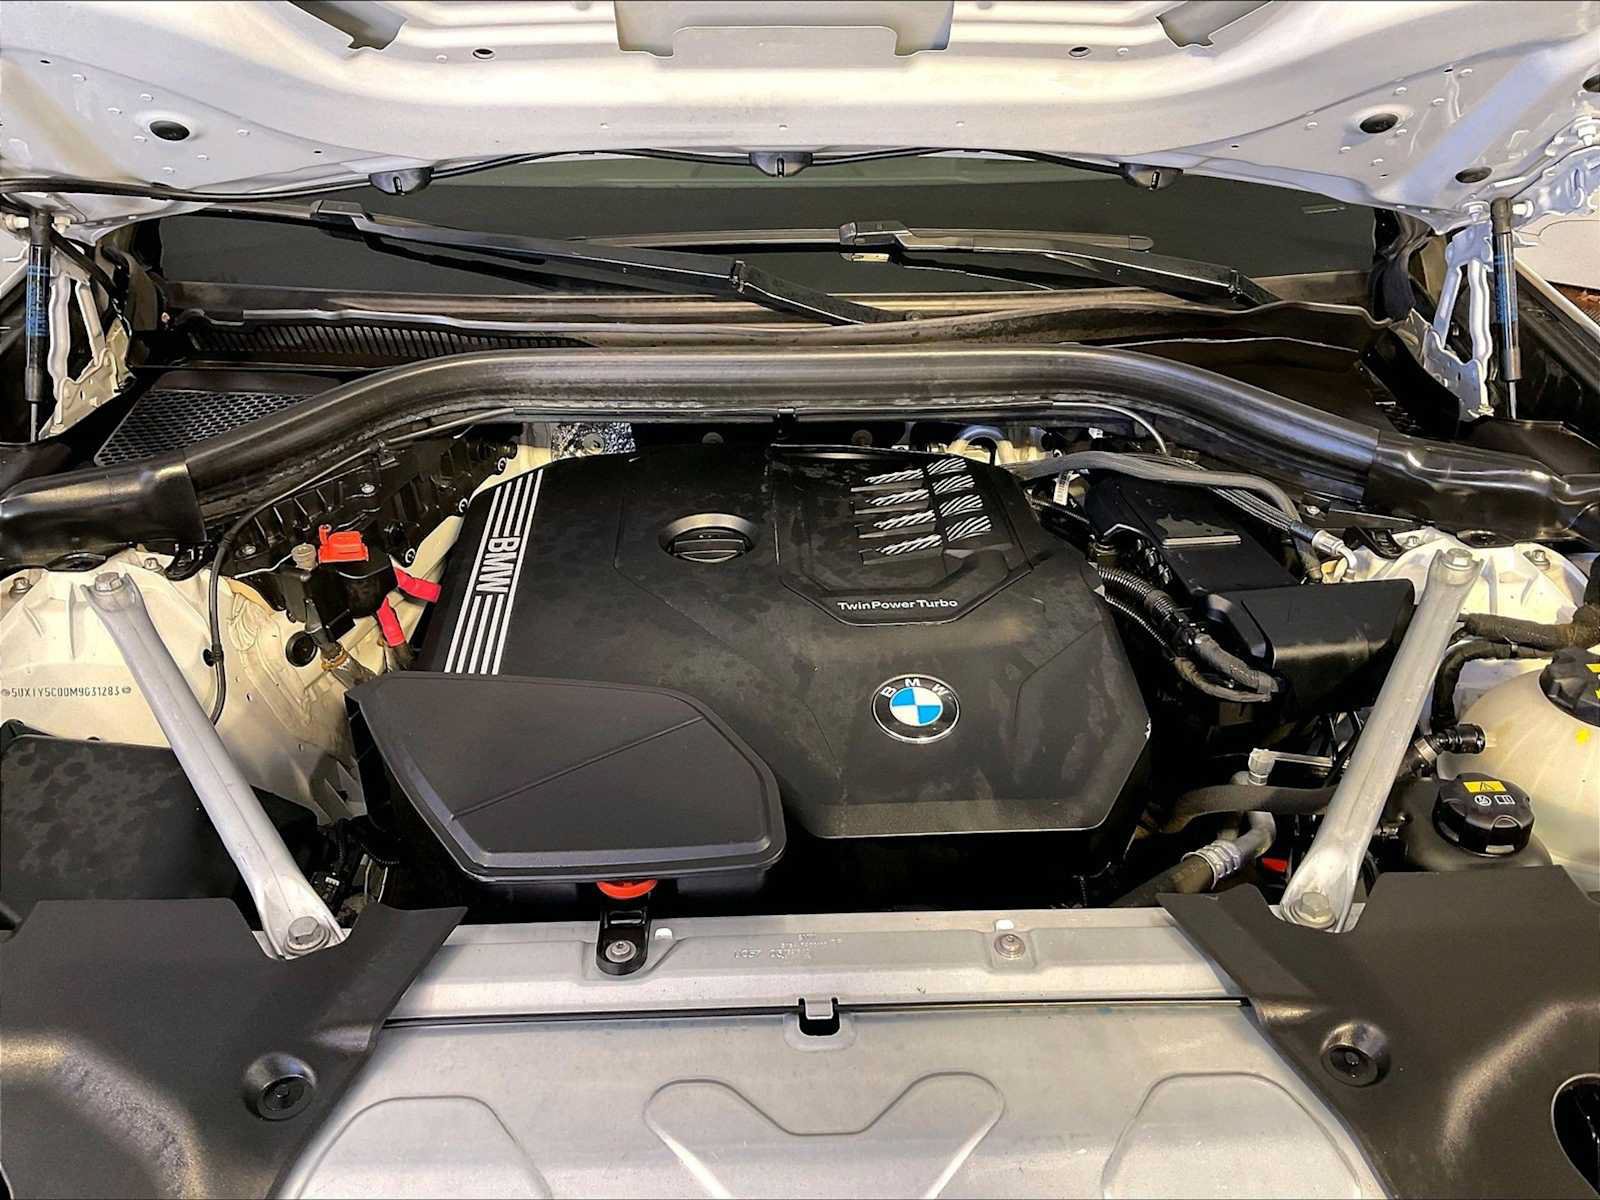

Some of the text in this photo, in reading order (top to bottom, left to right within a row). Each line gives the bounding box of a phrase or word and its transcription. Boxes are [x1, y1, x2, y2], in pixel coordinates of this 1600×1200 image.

[475, 537, 521, 593] BMW
[837, 599, 959, 610] TwinPower Turbo
[880, 678, 949, 698] BMW
